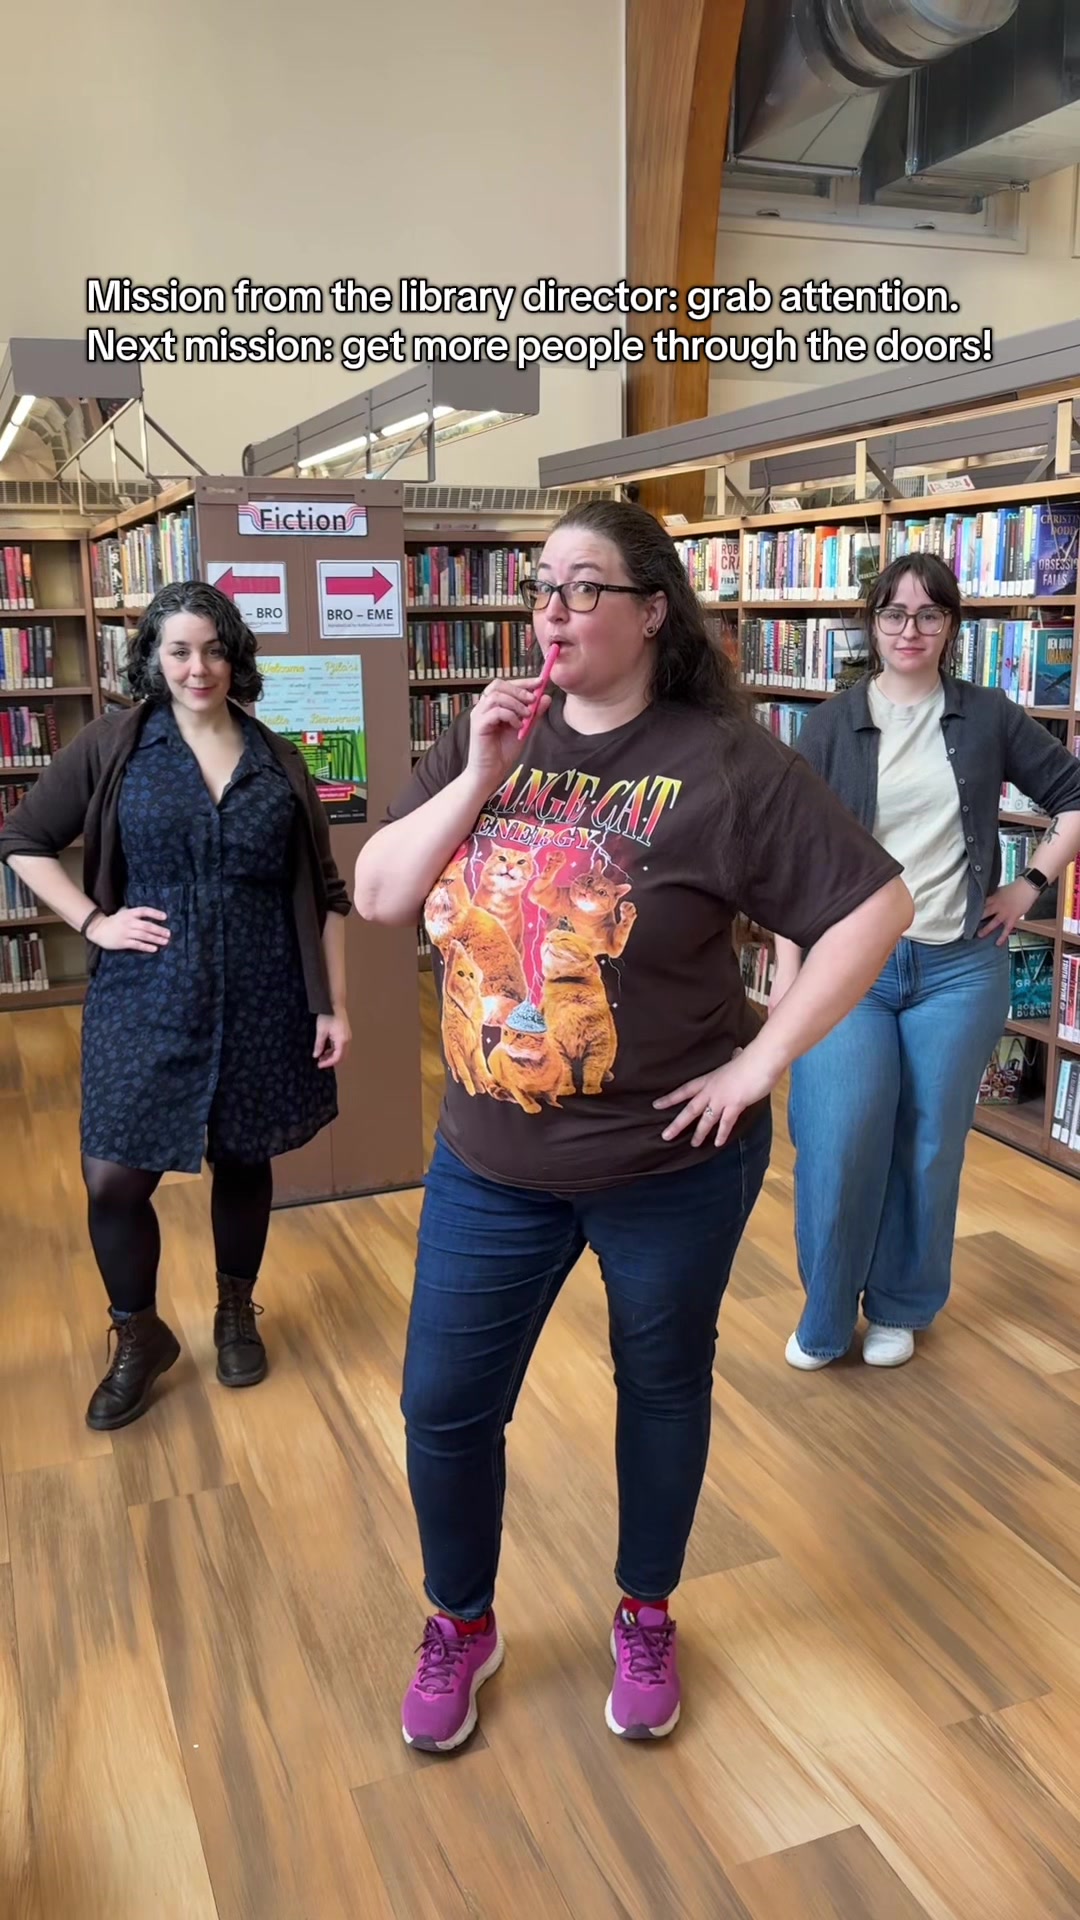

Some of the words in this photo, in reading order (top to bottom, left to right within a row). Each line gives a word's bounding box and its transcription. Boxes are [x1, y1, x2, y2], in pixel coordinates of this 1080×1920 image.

[260, 507, 347, 532] Fiction
[256, 607, 283, 619] BRO
[327, 609, 353, 620] BRO
[367, 609, 393, 620] EME
[256, 662, 305, 675] Welcome
[590, 775, 683, 847] CAT
[473, 813, 603, 850] ENERGY
